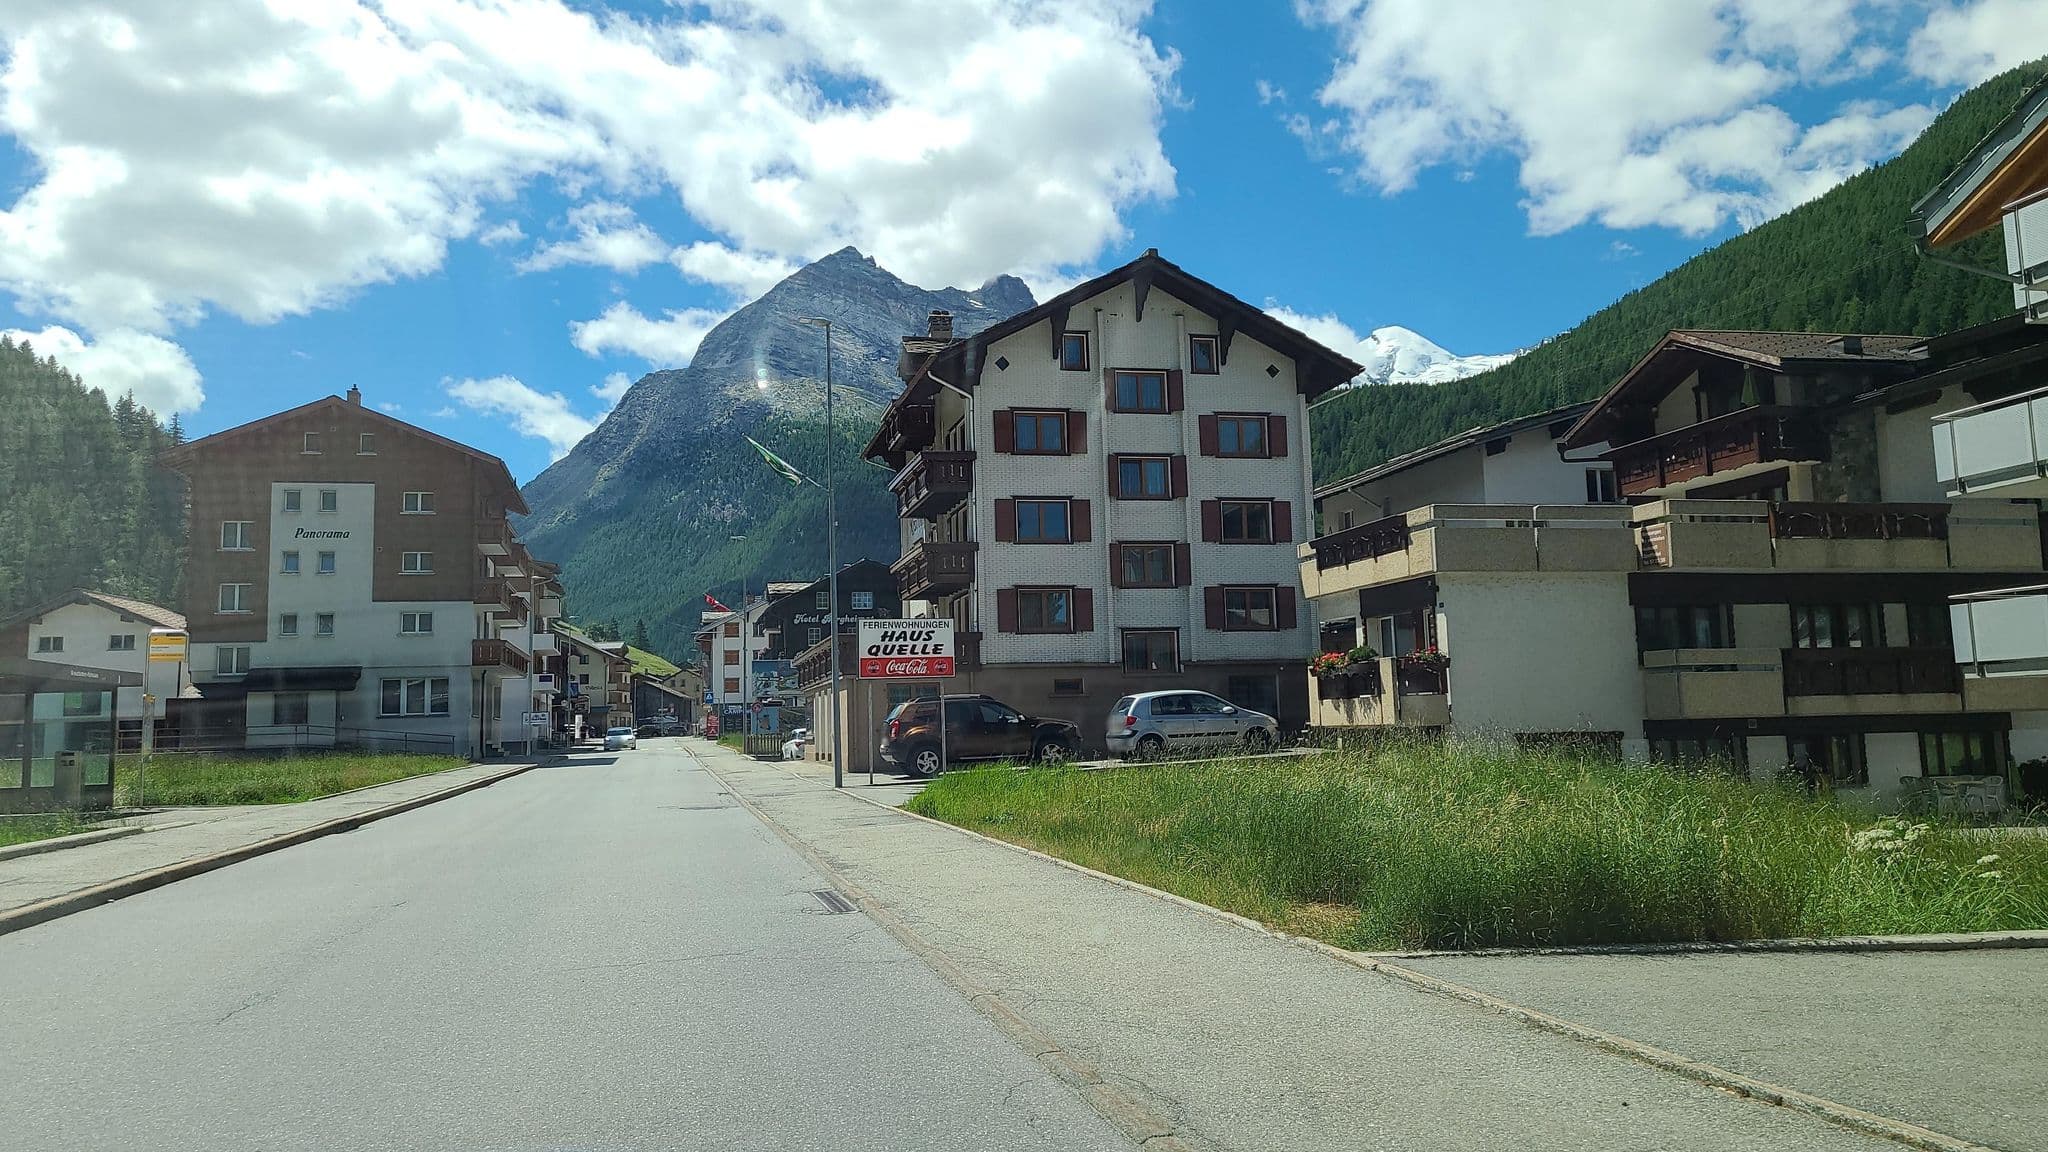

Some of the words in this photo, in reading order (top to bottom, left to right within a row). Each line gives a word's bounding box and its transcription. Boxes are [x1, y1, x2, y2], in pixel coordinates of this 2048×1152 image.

[294, 527, 350, 539] Panorama
[793, 613, 820, 625] Hotel
[821, 612, 874, 625] Brghei
[863, 621, 950, 630] FERIENWOHNUNGEN
[880, 630, 936, 642] HAUS
[867, 643, 945, 656] QUELLE
[885, 658, 929, 675] Coca-Cola
